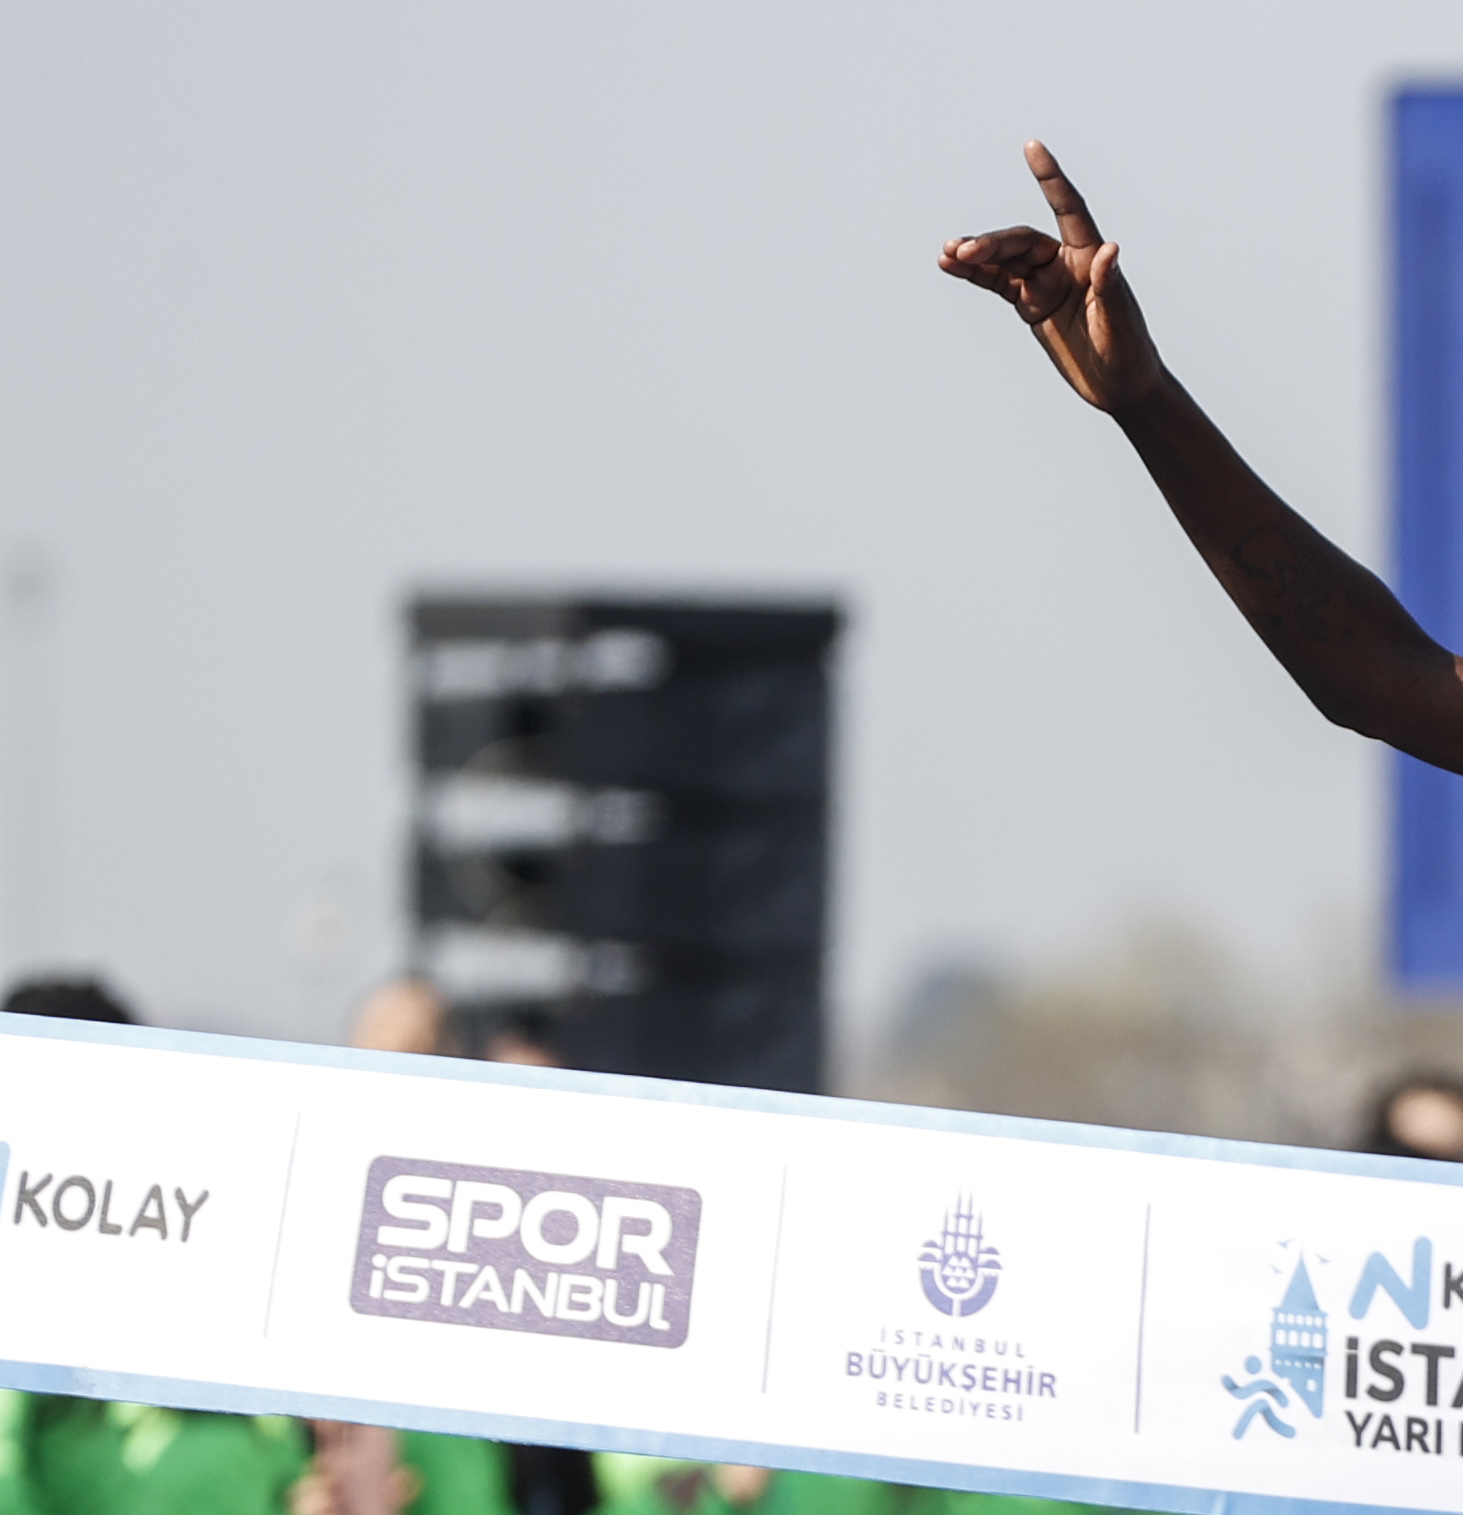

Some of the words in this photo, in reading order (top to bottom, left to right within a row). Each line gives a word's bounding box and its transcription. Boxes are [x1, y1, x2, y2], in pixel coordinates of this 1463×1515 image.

[14, 1170, 210, 1243] KOLAY
[377, 1174, 676, 1276] SPOR
[1346, 1411, 1442, 1455] YARI
